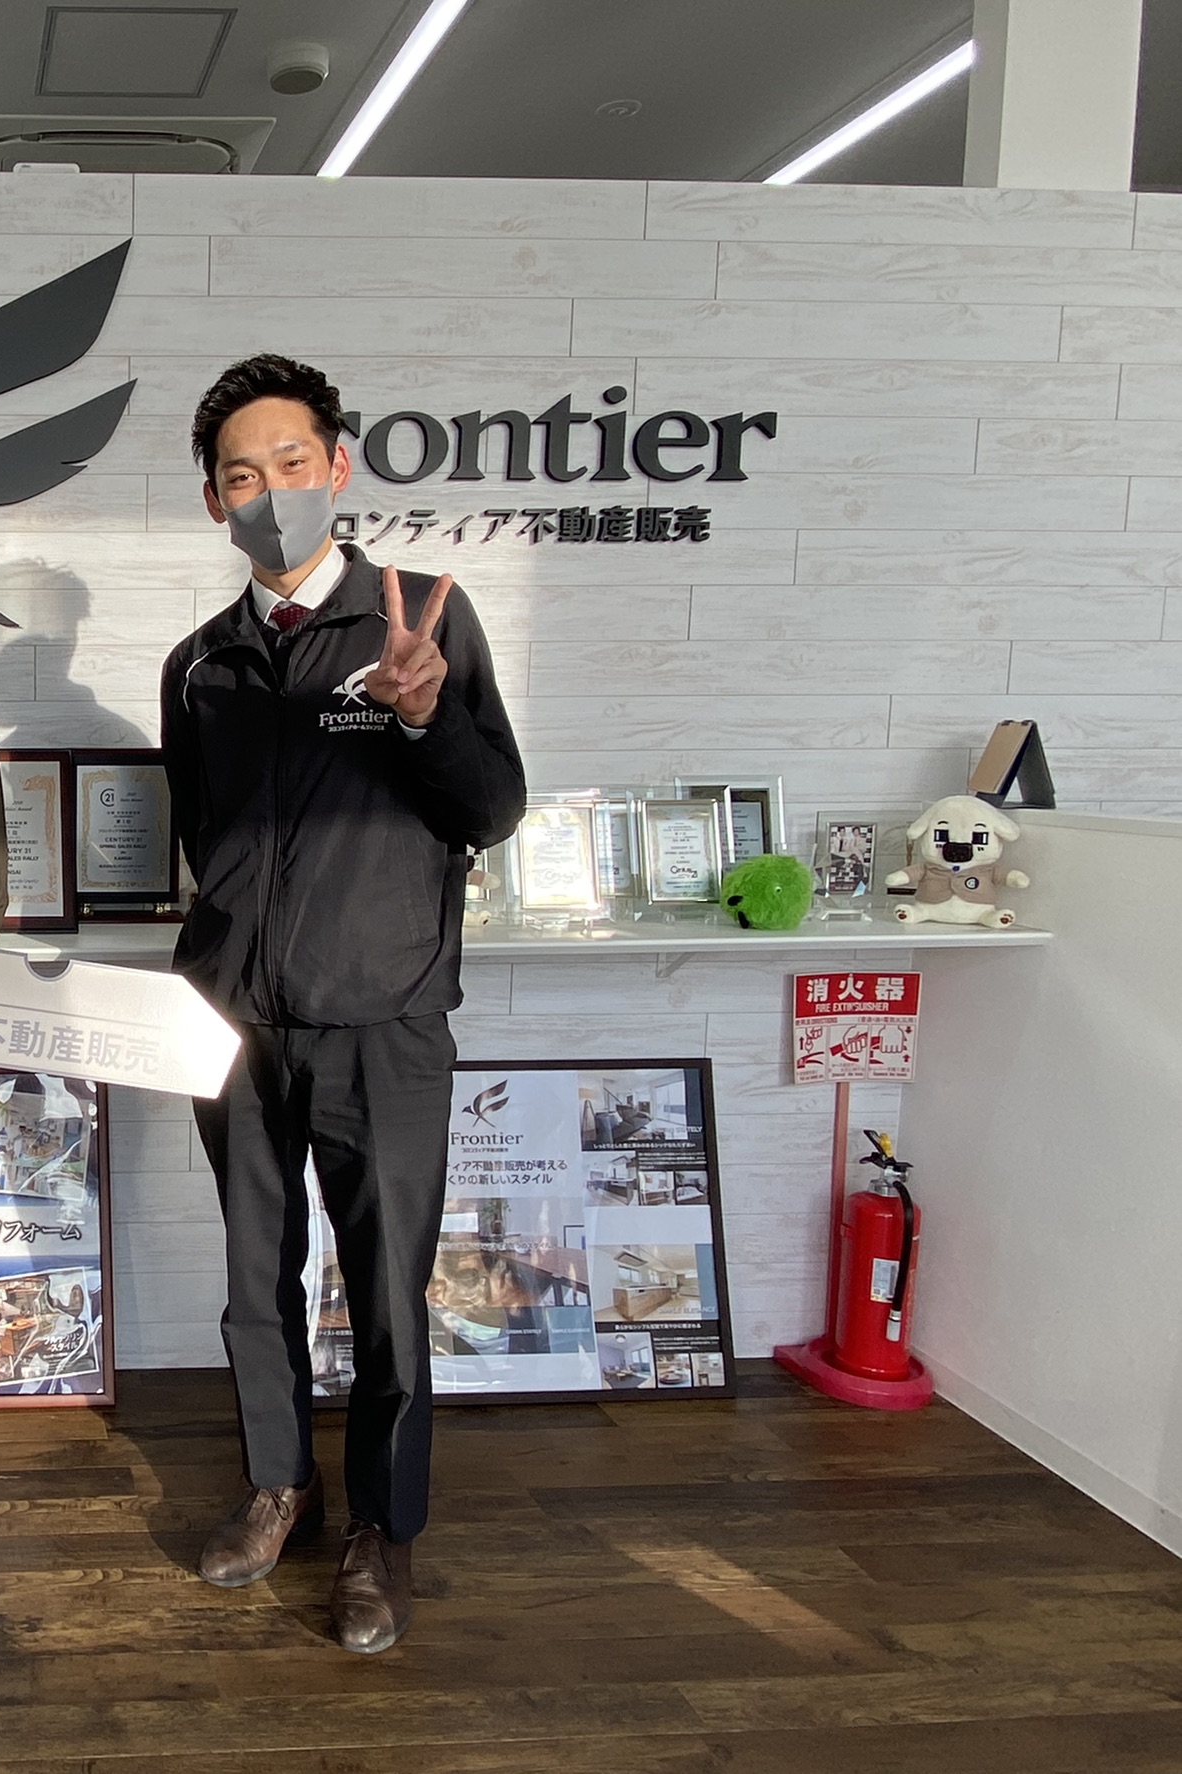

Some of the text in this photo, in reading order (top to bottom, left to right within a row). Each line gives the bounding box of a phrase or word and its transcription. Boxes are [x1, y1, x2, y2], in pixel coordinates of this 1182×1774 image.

[341, 385, 778, 484] ontier
[319, 709, 393, 727] Frontier
[806, 974, 905, 1003] 消火器
[815, 1002, 889, 1013] FIRE EXTINGUISHER
[450, 1132, 524, 1146] Frontier
[447, 1173, 553, 1185] くりの新しいスタイル
